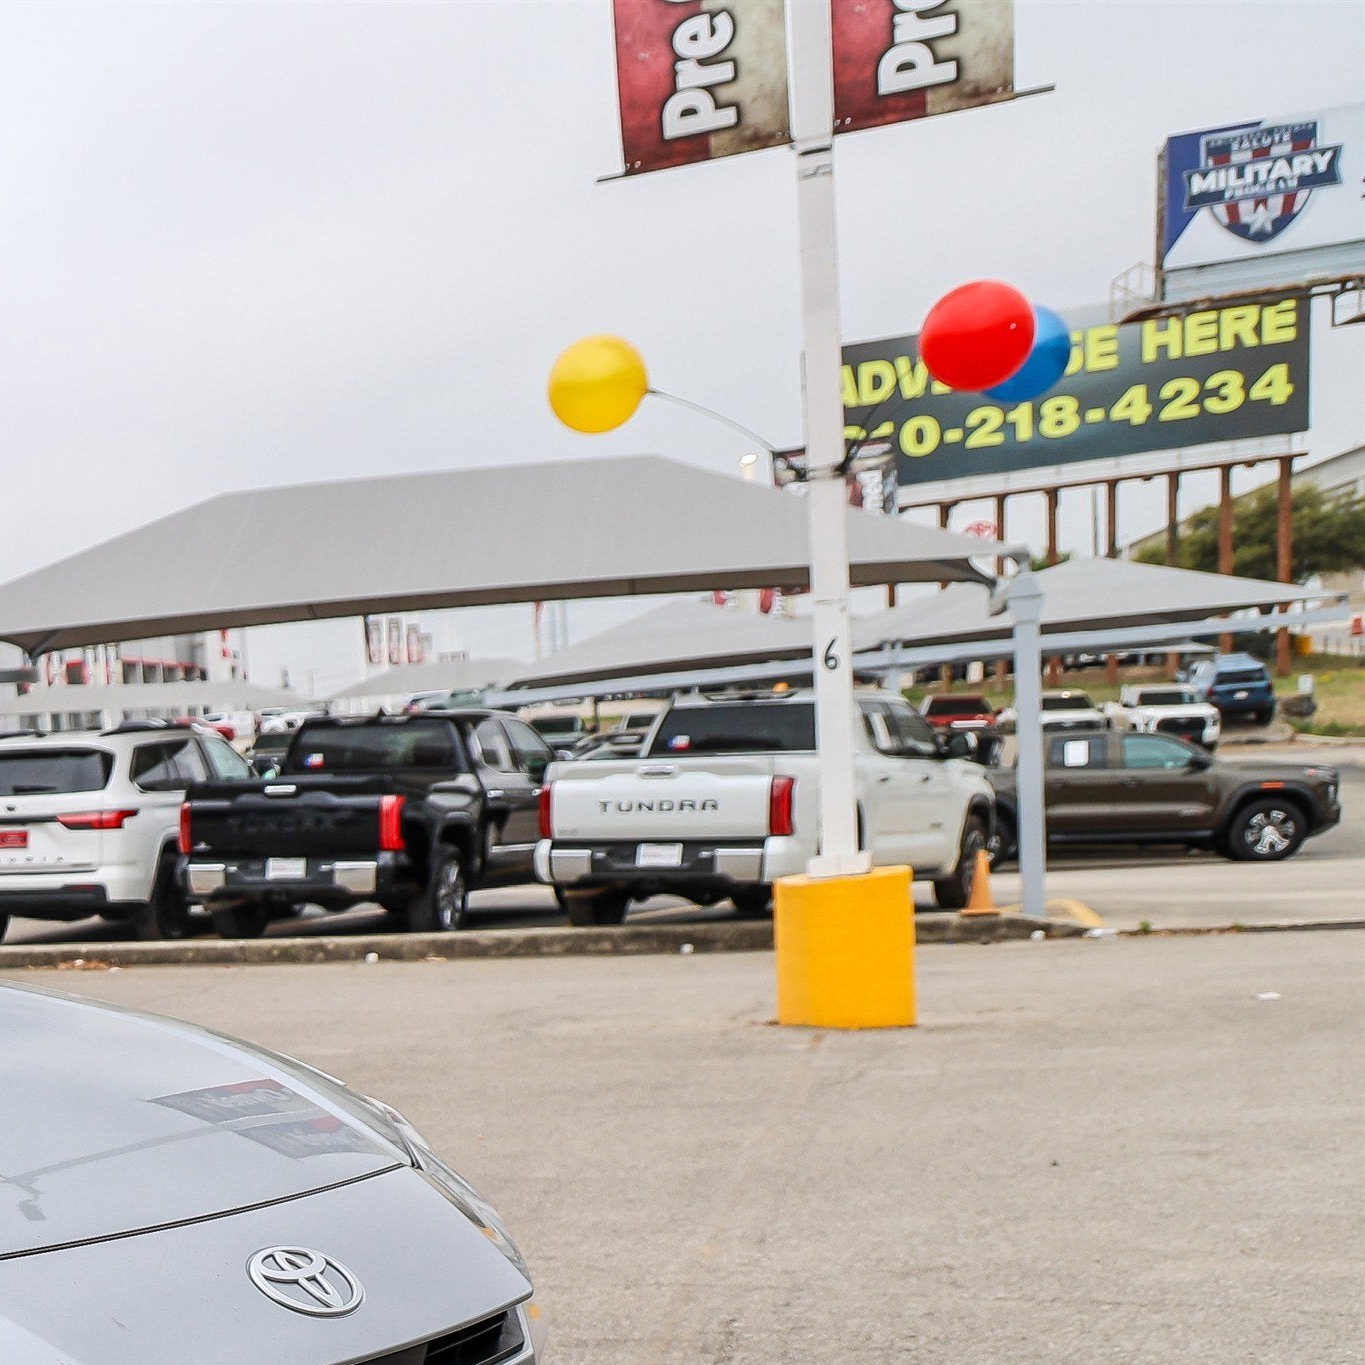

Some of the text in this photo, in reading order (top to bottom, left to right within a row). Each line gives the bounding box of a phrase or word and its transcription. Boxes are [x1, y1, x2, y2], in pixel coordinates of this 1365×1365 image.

[878, 0, 957, 96] Pr
[1190, 150, 1335, 195] MILITARY
[1141, 298, 1297, 363] HERE
[824, 637, 838, 671] 6
[598, 798, 720, 814] TUNDRA
